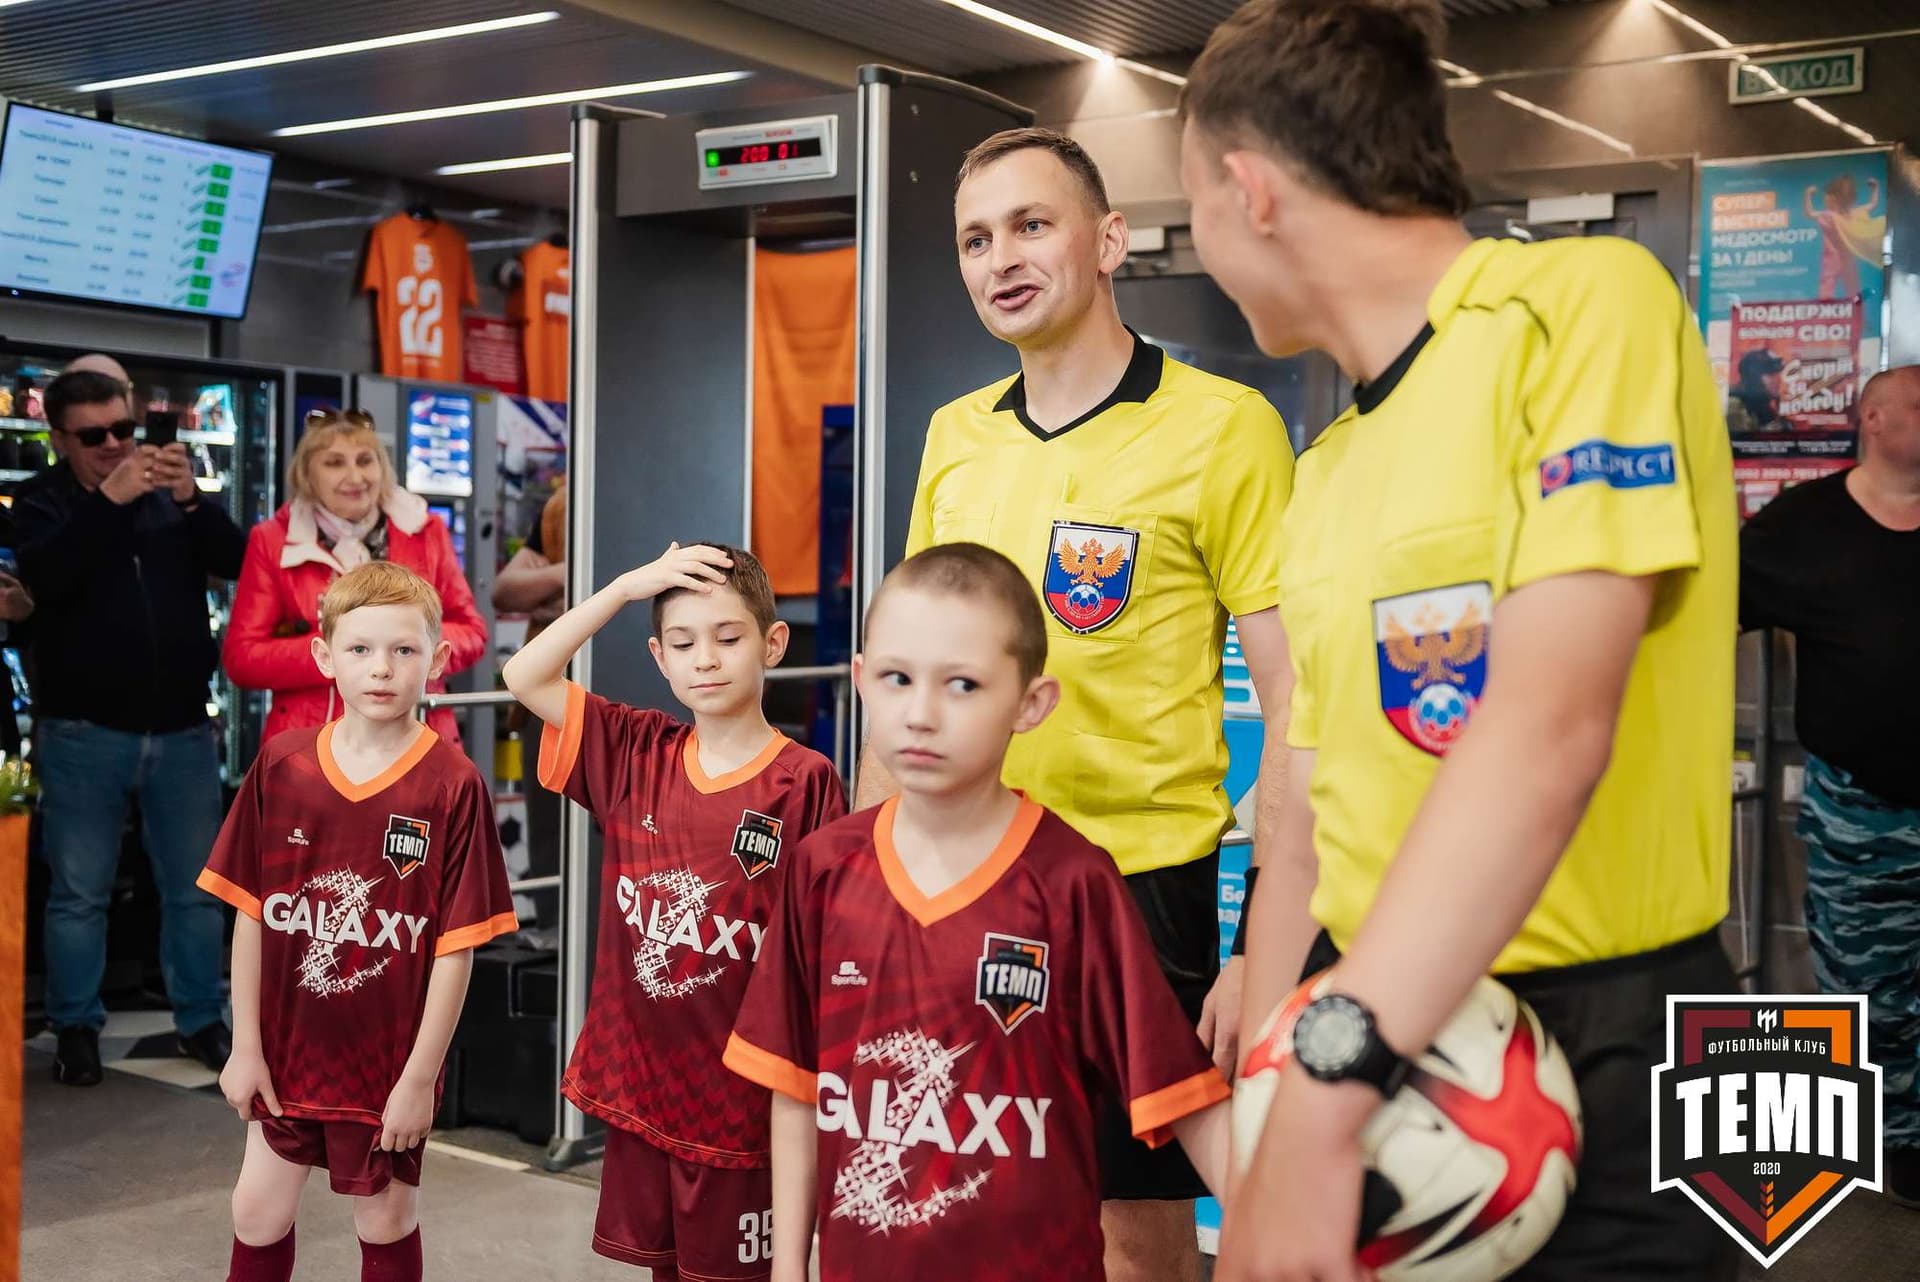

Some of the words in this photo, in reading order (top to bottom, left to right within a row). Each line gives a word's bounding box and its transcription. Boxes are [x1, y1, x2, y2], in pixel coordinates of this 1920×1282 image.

[397, 276, 443, 358] 22
[1740, 303, 1852, 322] ПОДДЕРЖИ
[389, 833, 425, 859] ТЕМП
[739, 830, 776, 860] ТЕМП
[263, 892, 428, 953] GALAXY
[616, 875, 768, 962] GALAXY
[985, 963, 1042, 1002] ТЕМП
[738, 1208, 774, 1263] 35
